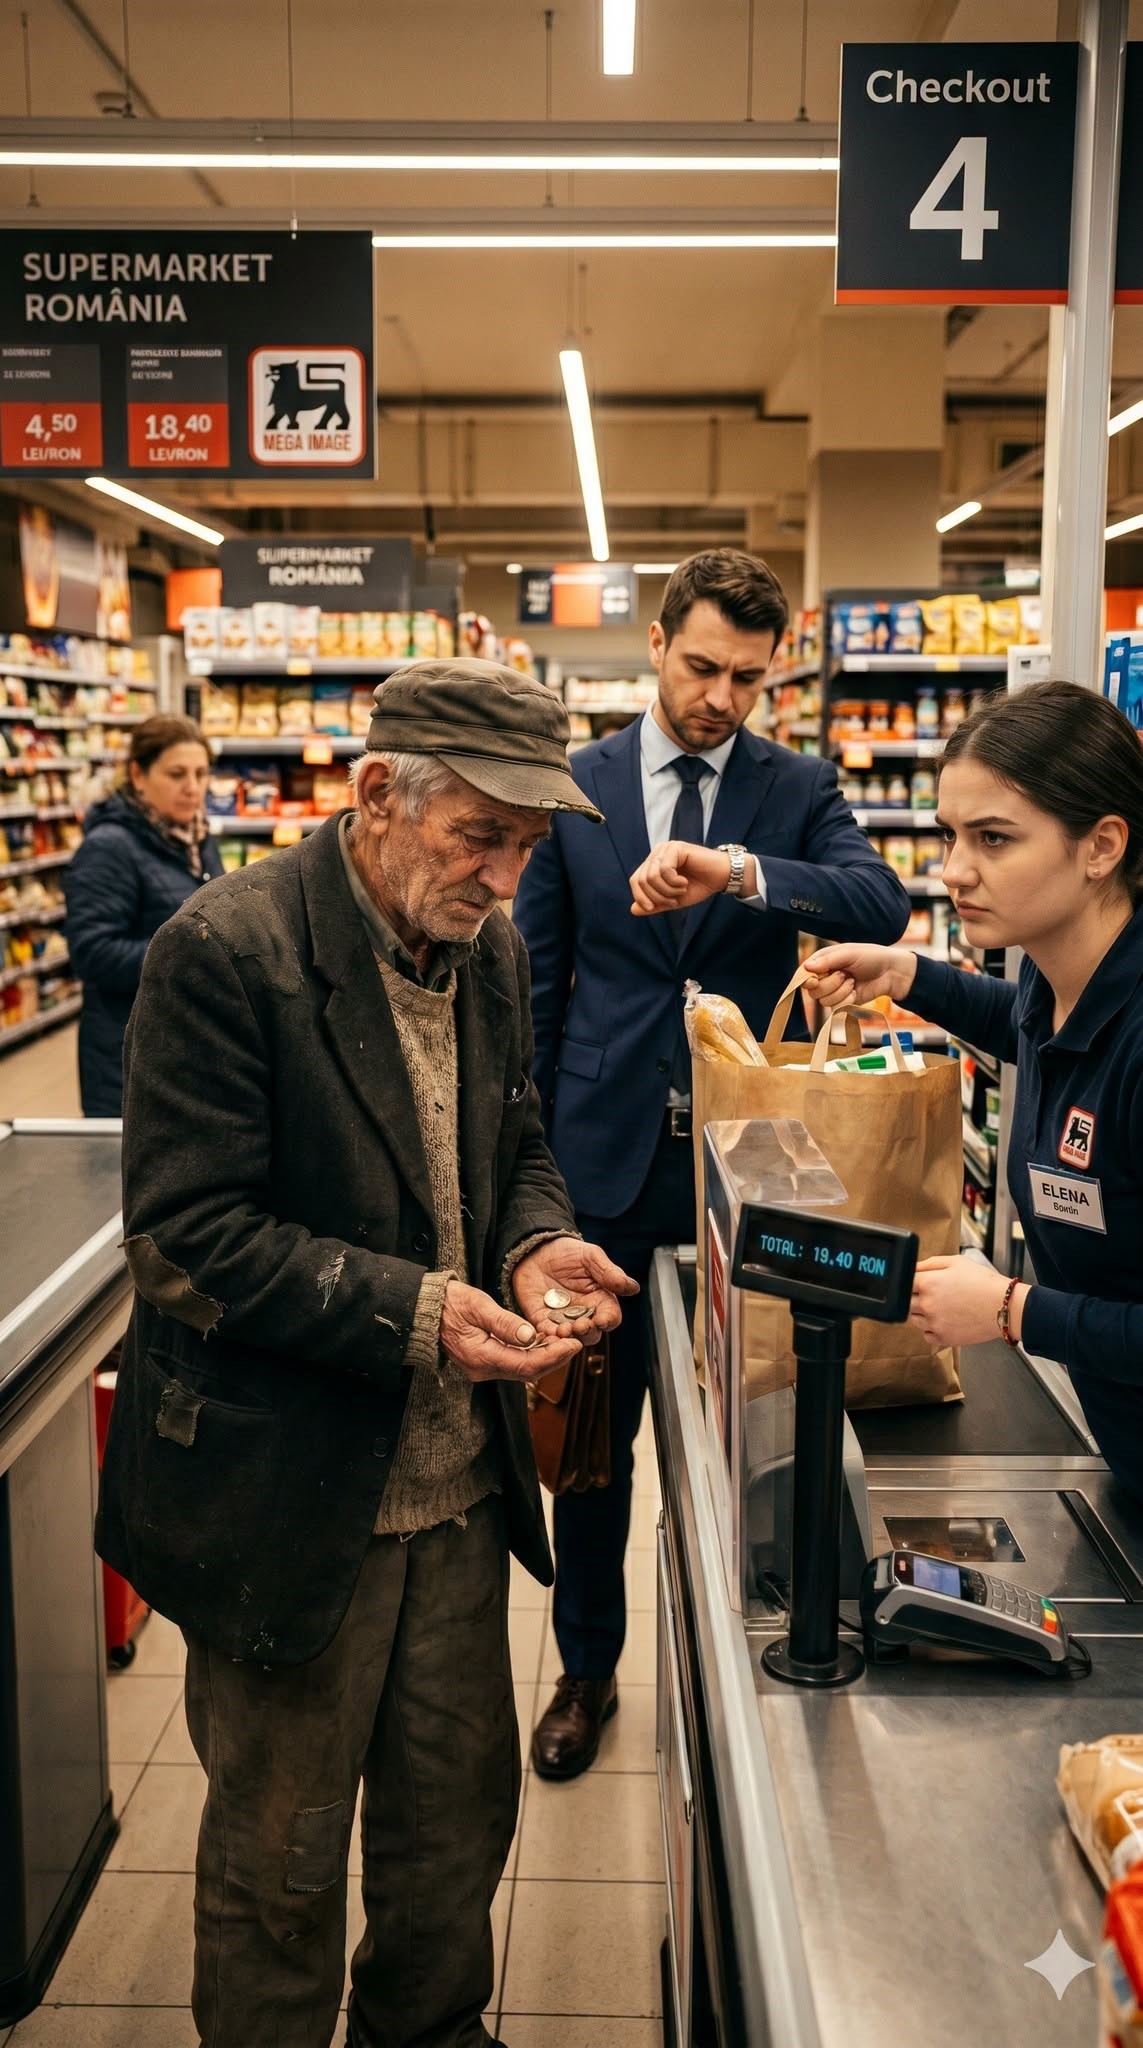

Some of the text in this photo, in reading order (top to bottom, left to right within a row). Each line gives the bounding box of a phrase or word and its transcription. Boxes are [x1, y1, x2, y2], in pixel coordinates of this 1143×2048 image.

[866, 69, 1051, 104] Checkout
[909, 136, 999, 261] 4
[23, 253, 272, 282] SUPERMARKET
[25, 288, 187, 322] ROMÂNIA
[25, 413, 77, 443] 4,50
[145, 413, 212, 443] 18,40
[263, 433, 352, 451] MEGA IMAGE
[22, 447, 82, 461] LEI/RON
[1042, 1182, 1090, 1207] ELENA
[760, 1234, 886, 1277] TOTAL: 19.40 RON
